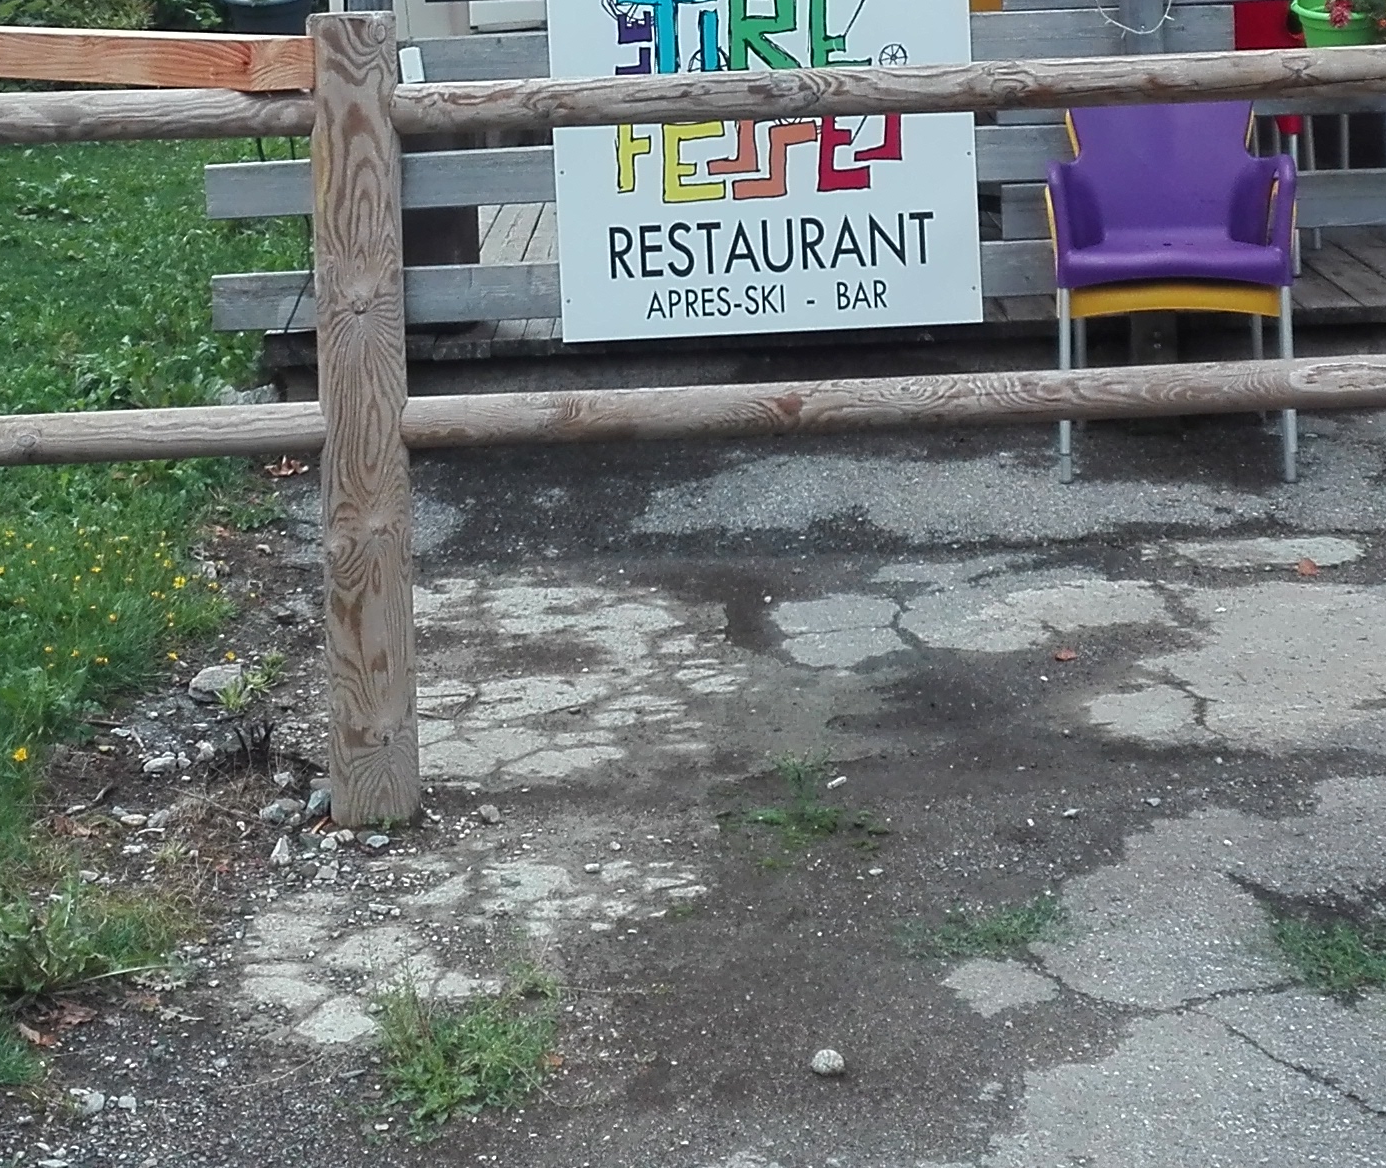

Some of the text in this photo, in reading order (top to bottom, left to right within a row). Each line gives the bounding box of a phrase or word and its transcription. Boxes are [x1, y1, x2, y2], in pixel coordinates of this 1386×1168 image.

[608, 210, 935, 281] RESTAURANT
[646, 283, 786, 320] APRES-SKI
[835, 279, 889, 310] BAR
